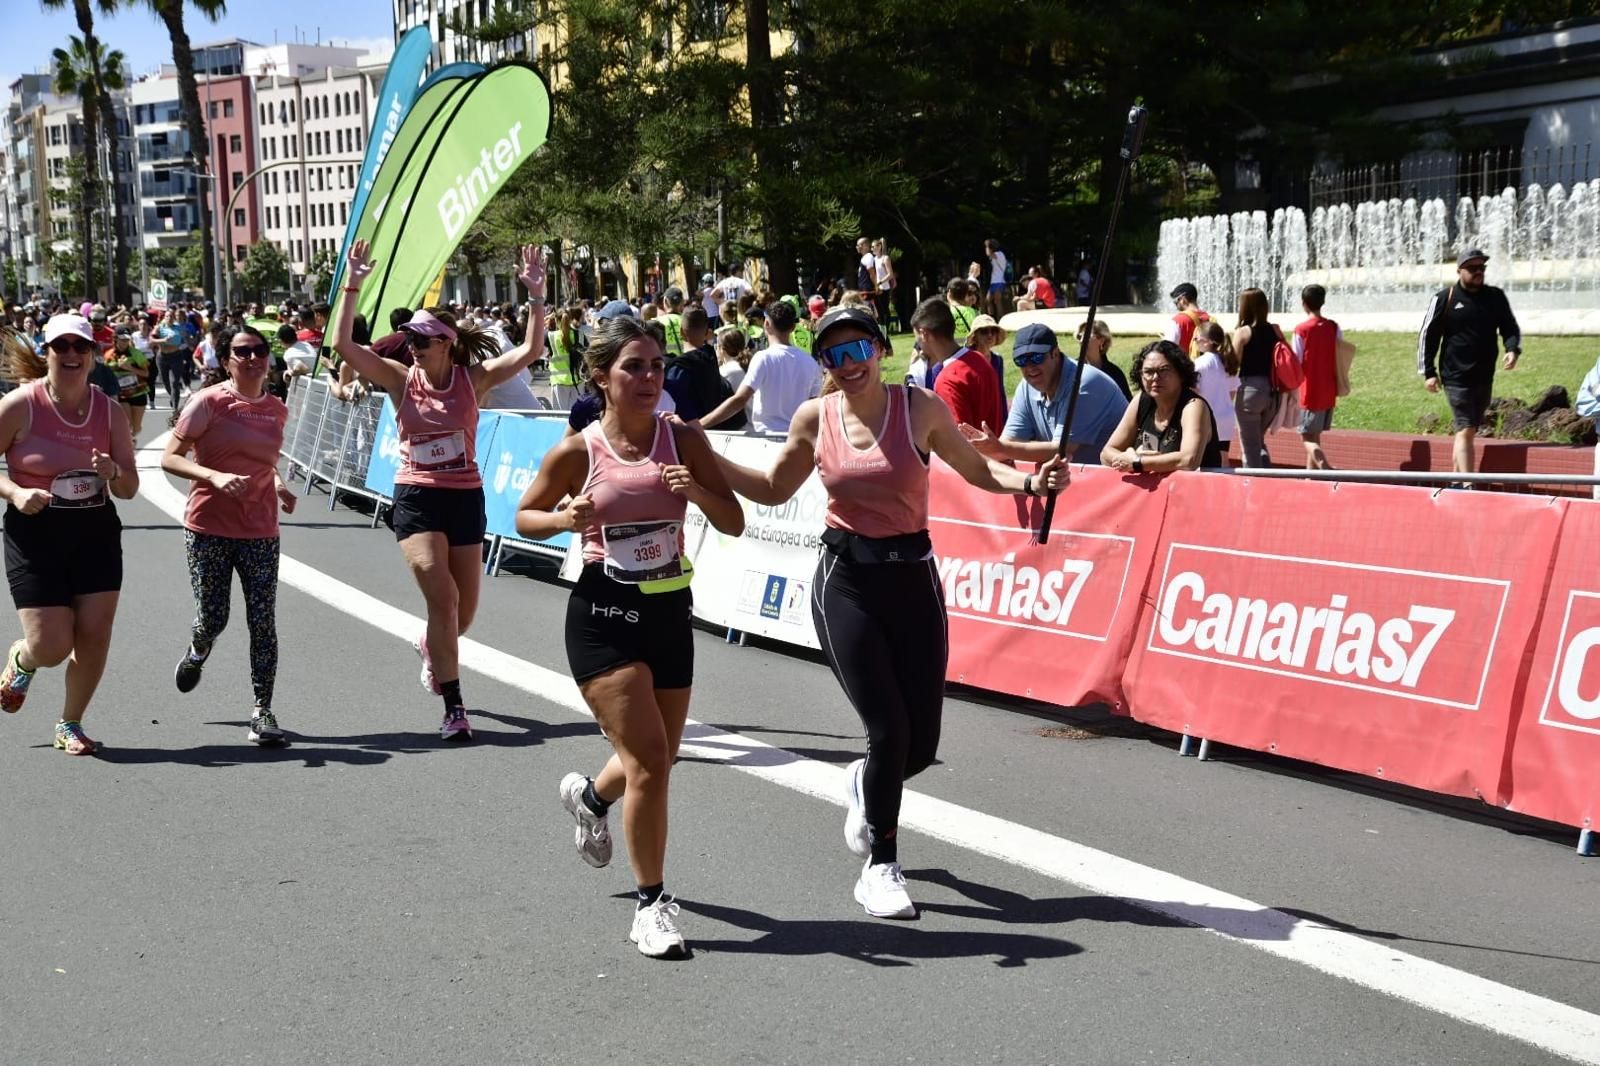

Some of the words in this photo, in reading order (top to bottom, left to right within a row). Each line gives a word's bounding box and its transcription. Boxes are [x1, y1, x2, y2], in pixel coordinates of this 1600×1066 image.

[437, 121, 522, 241] Binter
[633, 543, 662, 562] 3399
[761, 525, 801, 548] Europea
[591, 602, 640, 623] HPS
[933, 551, 1094, 626] narias7
[1159, 571, 1456, 688] Canarias7
